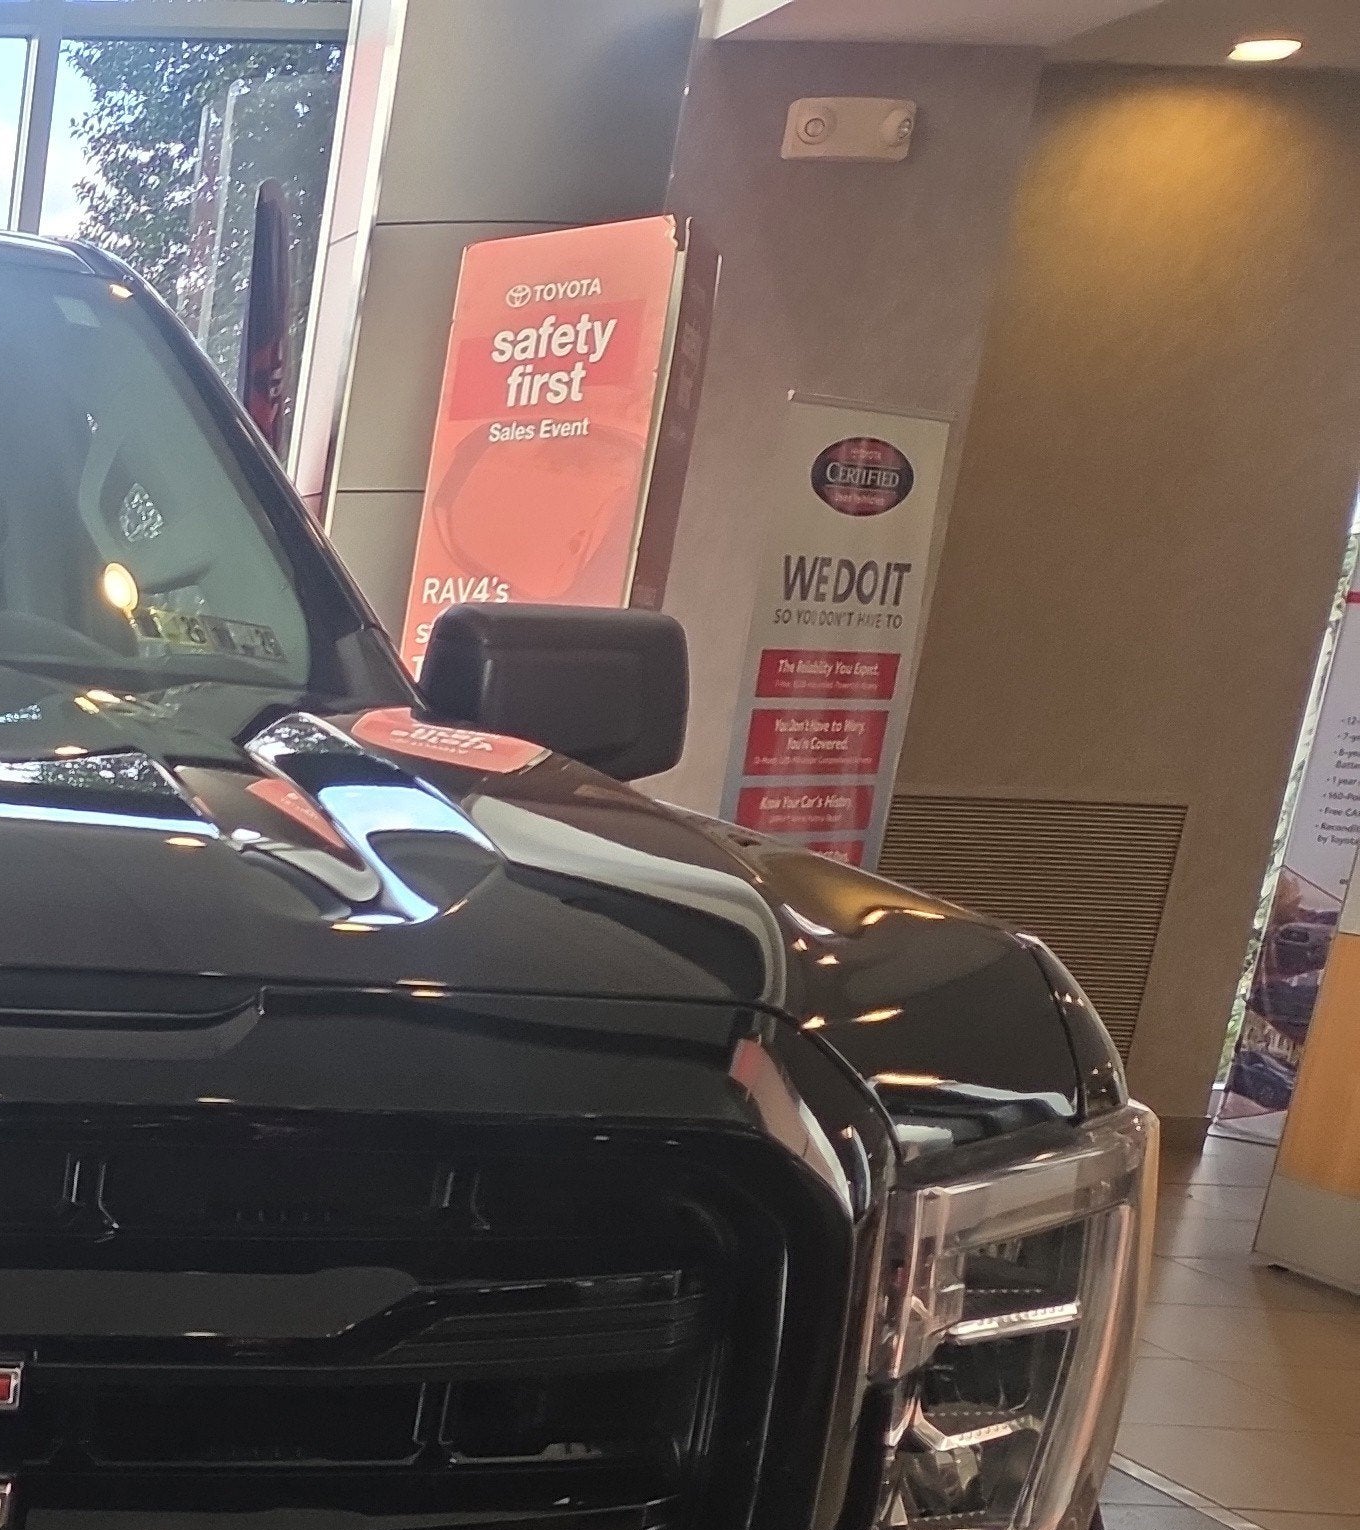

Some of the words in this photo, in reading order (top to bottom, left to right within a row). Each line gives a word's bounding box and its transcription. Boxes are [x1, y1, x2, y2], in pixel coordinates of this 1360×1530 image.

[534, 278, 602, 301] TOYOTA
[491, 313, 618, 363] safety
[506, 361, 587, 407] first
[488, 421, 536, 442] Sales
[539, 417, 590, 439] Event
[825, 461, 900, 488] CERTIFIED
[422, 576, 510, 604] RAV4's
[783, 554, 833, 602] WE
[831, 558, 879, 605] DO
[879, 561, 912, 606] IT
[773, 608, 792, 624] SO
[818, 610, 854, 627] DON'T
[886, 613, 903, 629] TO
